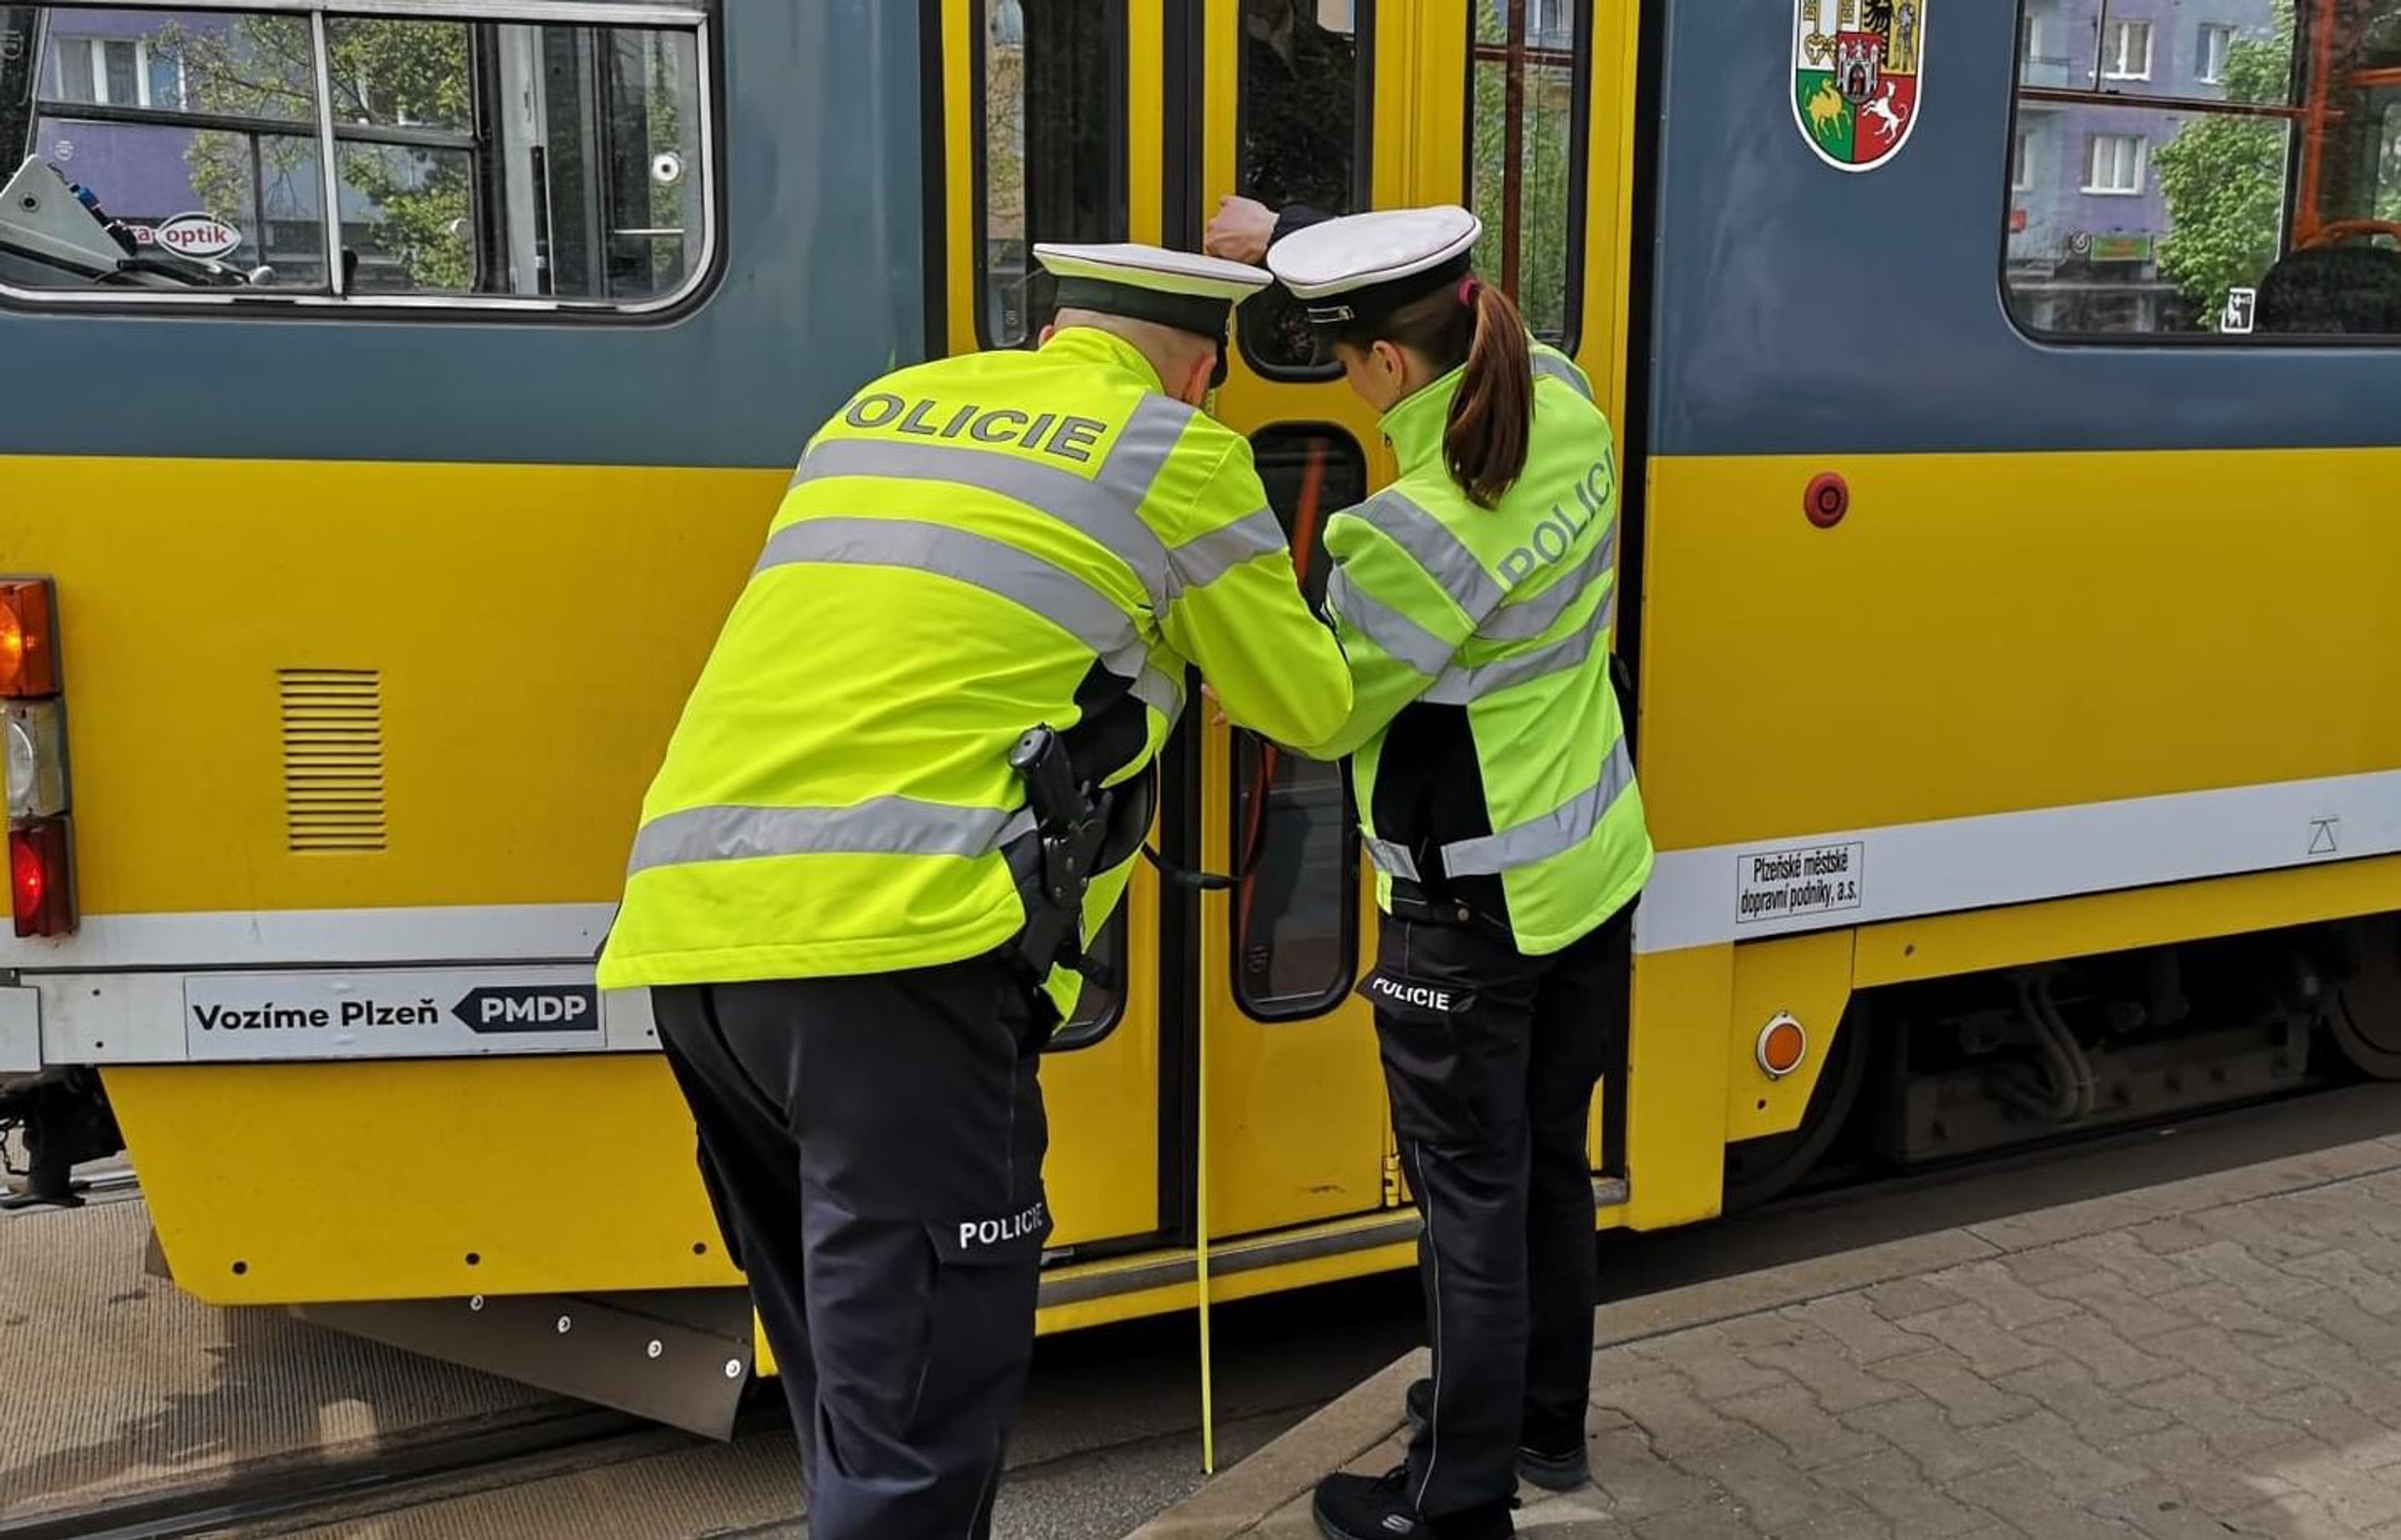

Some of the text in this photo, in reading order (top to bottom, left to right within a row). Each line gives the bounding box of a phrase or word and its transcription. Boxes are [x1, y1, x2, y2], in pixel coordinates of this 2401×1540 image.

[165, 227, 228, 246] optik
[838, 394, 1108, 463] OLICIE
[1754, 848, 1848, 882] Plzeňské městské
[1741, 880, 1857, 918] dopravní podniky, a.s.
[193, 995, 587, 1030] Vozíme Plzeň PMDP
